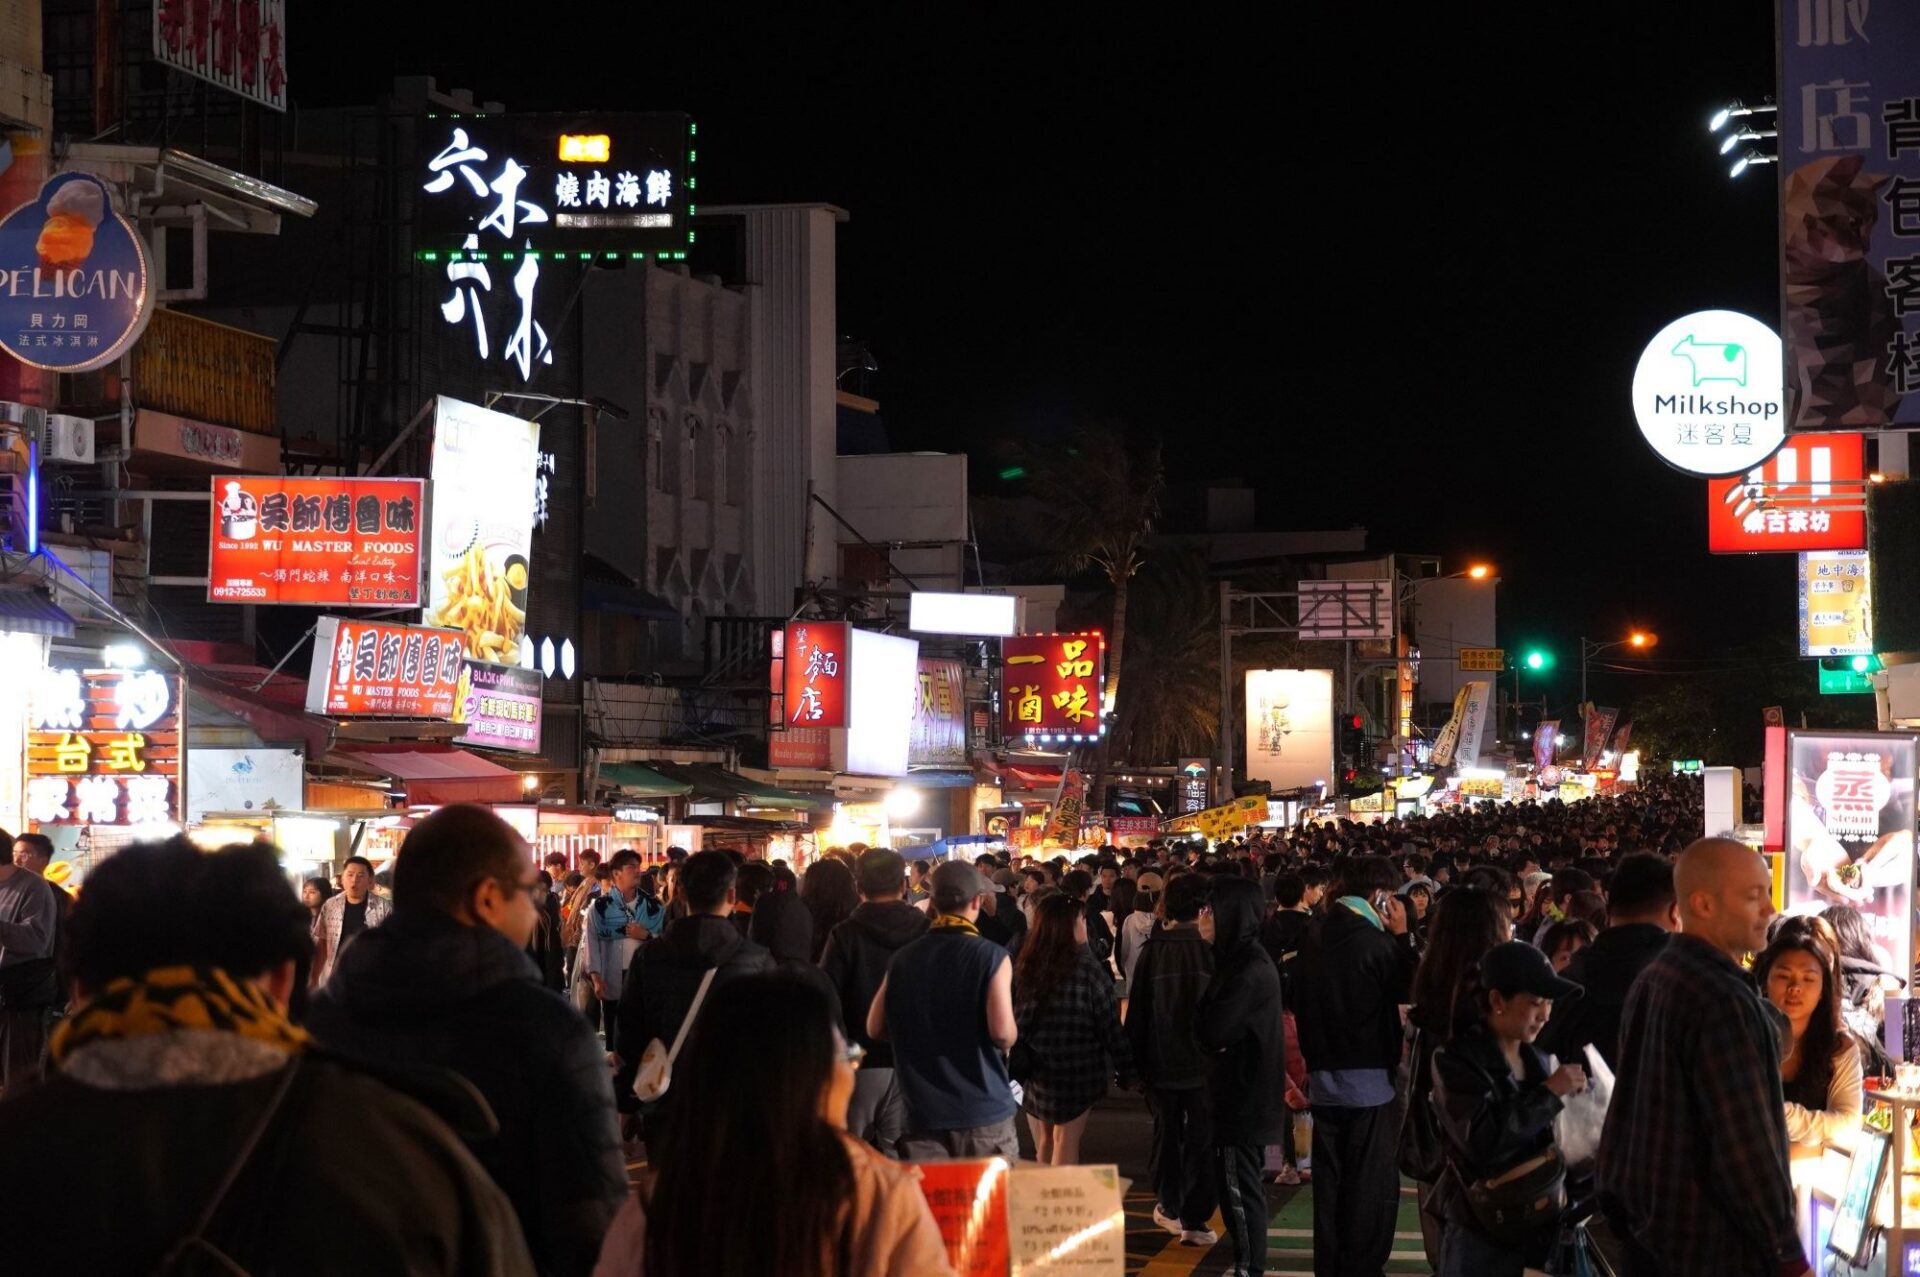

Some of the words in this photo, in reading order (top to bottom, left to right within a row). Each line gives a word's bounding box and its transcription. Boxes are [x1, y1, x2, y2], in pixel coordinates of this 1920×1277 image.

[556, 169, 672, 208] 燒肉海鮮
[30, 313, 88, 328] 貝力岡
[19, 334, 98, 347] 法式冰淇淋
[1655, 394, 1778, 420] Milkshop
[1677, 423, 1753, 445] 迷客夏
[262, 541, 283, 551] WU
[292, 541, 353, 553] MASTER
[364, 542, 414, 554] FOODS
[1817, 564, 1865, 576] 地中海
[365, 686, 394, 696] MASTER
[397, 687, 420, 698] FOODS
[792, 644, 838, 723] 麵店
[55, 733, 146, 772] 台式
[1832, 770, 1874, 811] 蒸
[1832, 814, 1873, 824] steam
